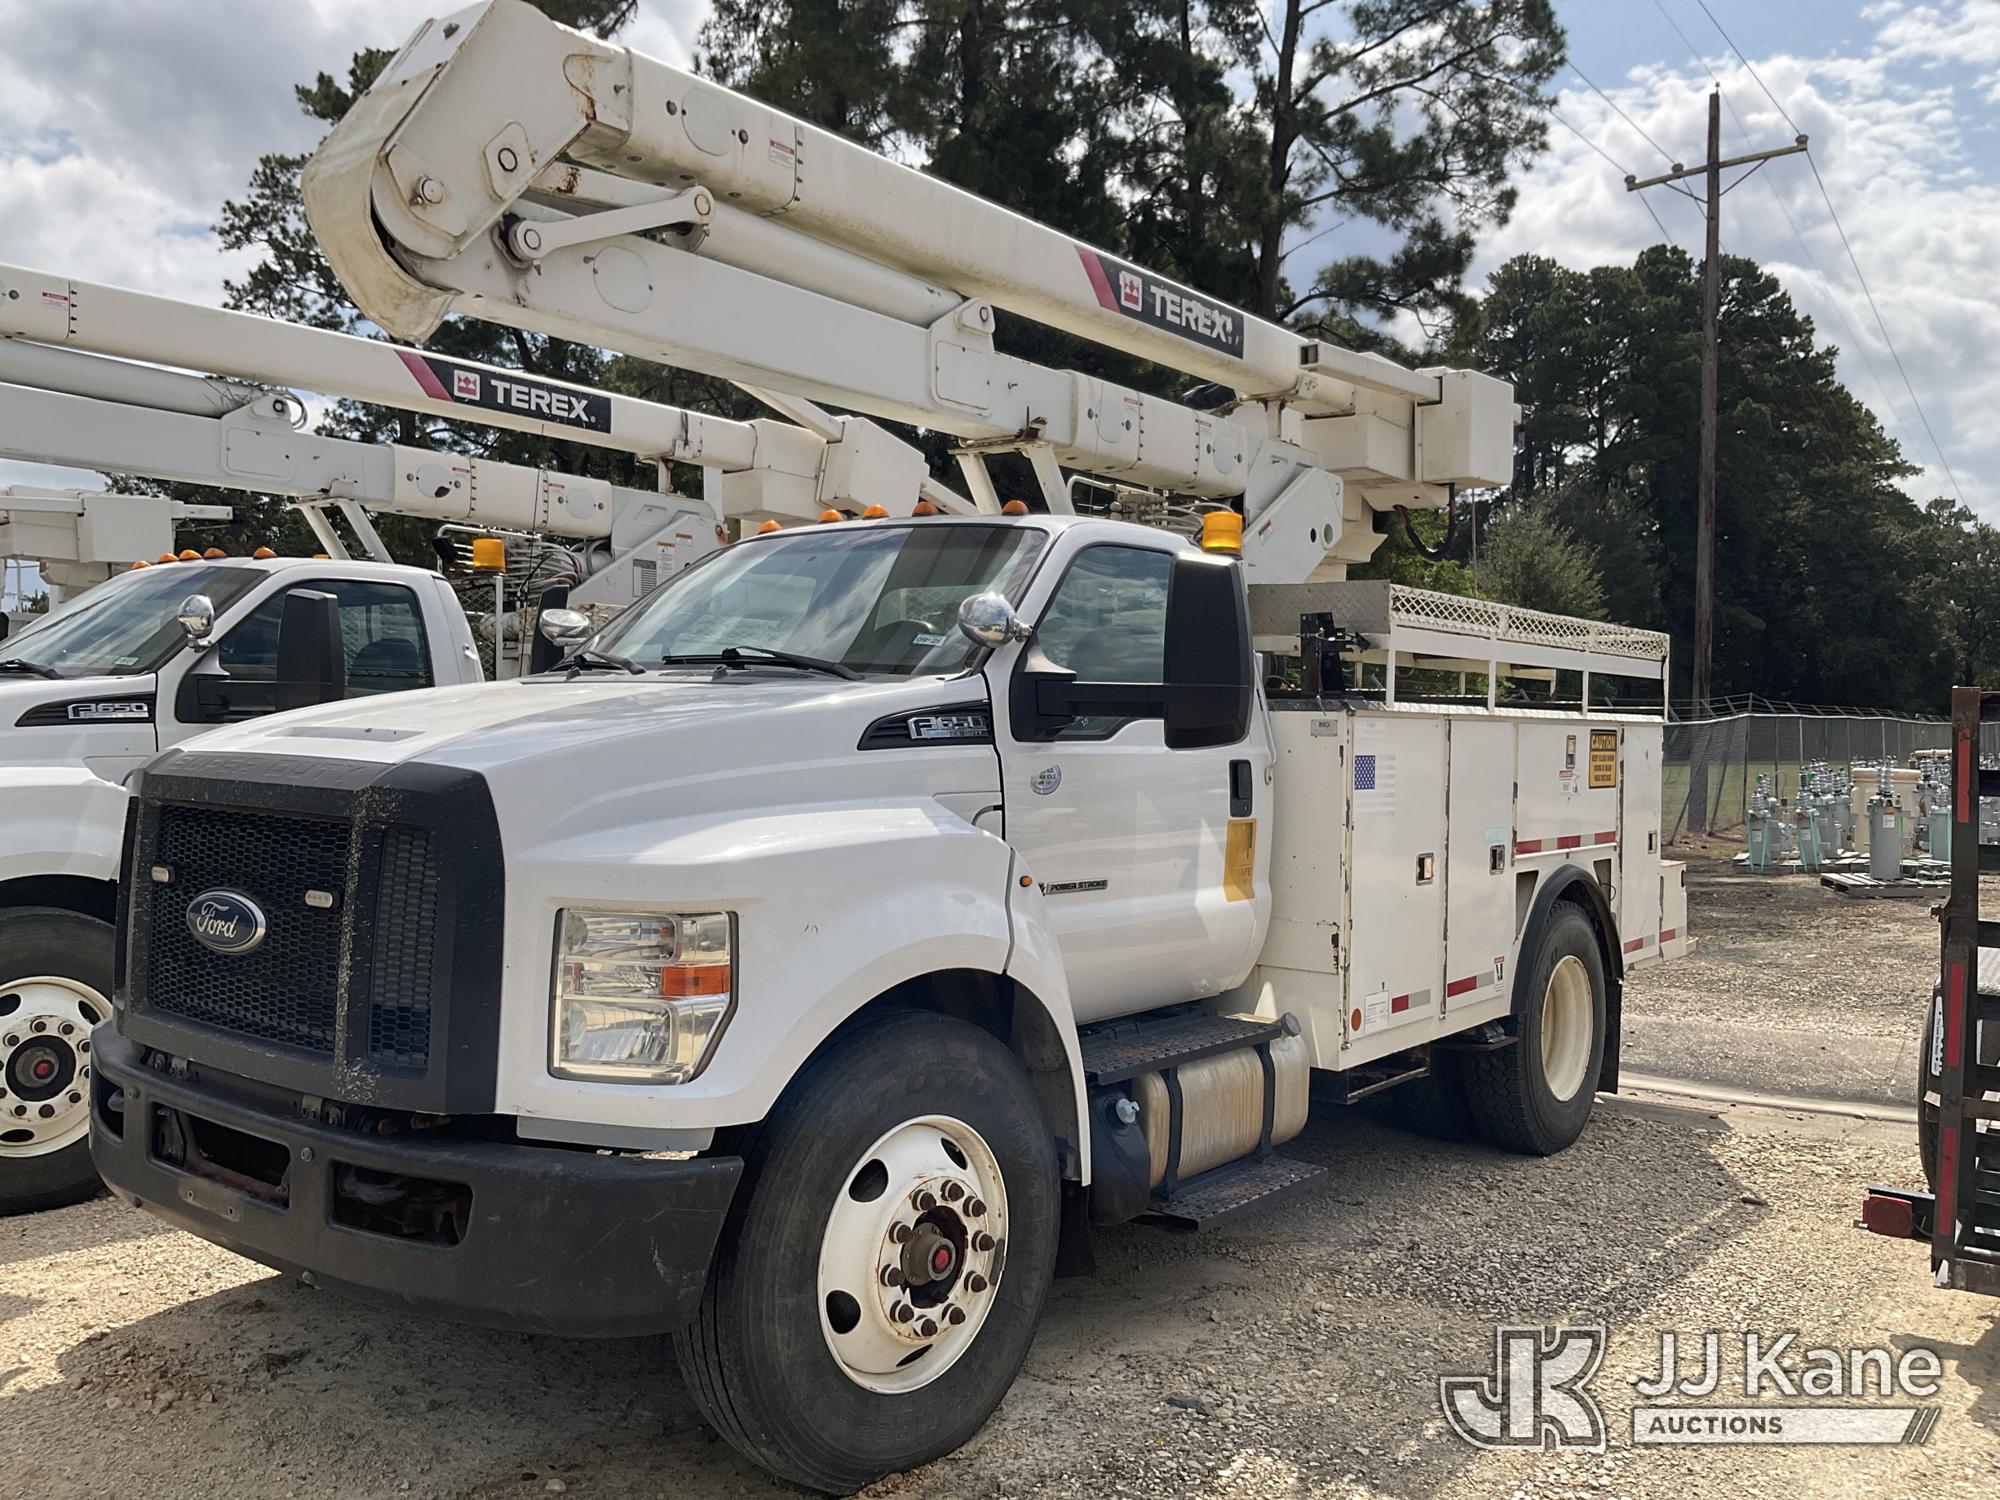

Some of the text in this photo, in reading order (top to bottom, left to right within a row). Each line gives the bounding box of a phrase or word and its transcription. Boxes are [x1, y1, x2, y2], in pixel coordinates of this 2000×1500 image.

[1150, 285, 1227, 343] TEREX
[491, 379, 589, 422] TEREX
[1592, 735, 1616, 750] CAUTION
[1050, 880, 1107, 891] POWER STROKE
[196, 901, 239, 938] Ford
